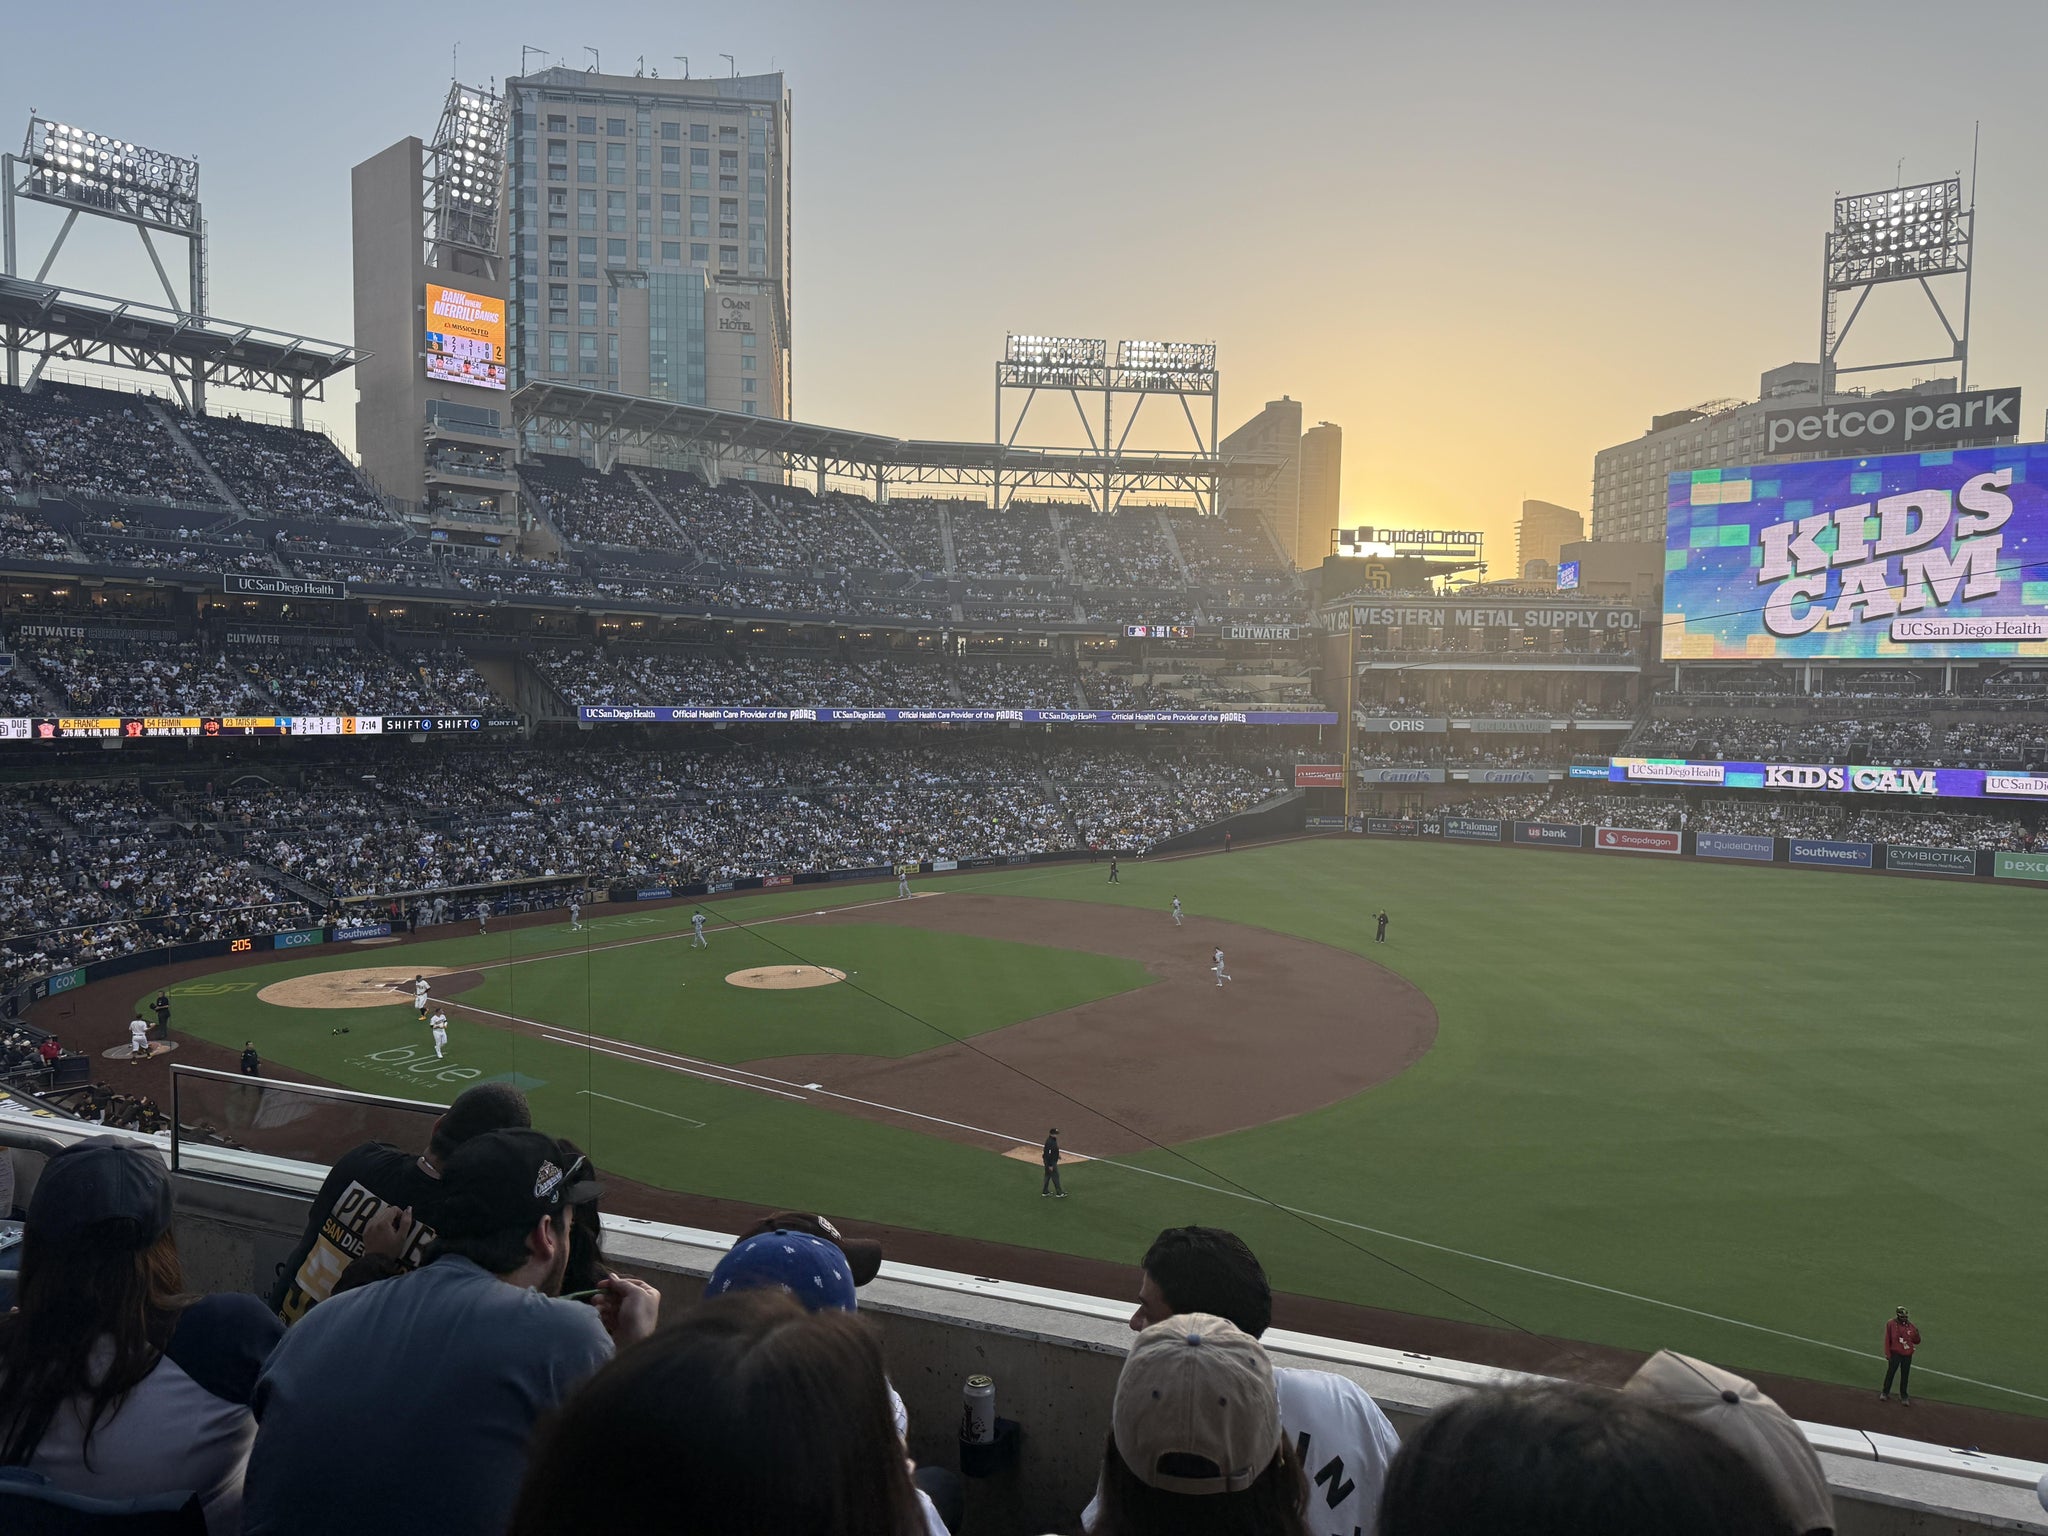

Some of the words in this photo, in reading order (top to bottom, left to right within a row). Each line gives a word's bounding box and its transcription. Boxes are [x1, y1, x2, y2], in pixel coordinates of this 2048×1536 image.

[441, 290, 466, 305] BANK
[433, 300, 476, 322] MERRILL
[475, 309, 500, 324] BANKS
[452, 323, 477, 334] MISSION
[451, 336, 456, 344] 2
[469, 339, 473, 348] 3
[451, 345, 456, 353] 2
[496, 346, 502, 357] 2
[1768, 408, 1895, 452] petco
[1904, 395, 2015, 441] park
[1757, 467, 2014, 584] KIDS
[1378, 529, 1477, 545] QuidelOrtho
[239, 578, 254, 590] UC
[254, 579, 275, 591] San
[276, 581, 303, 595] Diego
[304, 583, 334, 595] Health
[1763, 533, 2005, 637] CAM
[1353, 607, 1445, 626] WESTERN
[1455, 609, 1519, 627] METAL
[1525, 610, 1599, 628] SUPPLY
[1606, 611, 1639, 629] CO.
[20, 625, 85, 638] CUTWATER
[1231, 627, 1290, 639] CUTWATER
[1900, 623, 1923, 636] UC
[1924, 623, 1950, 636] San
[1953, 622, 1993, 637] Diego
[1995, 621, 2042, 635] Health
[226, 633, 280, 645] CUTWATER
[586, 708, 599, 718] UC
[599, 708, 612, 718] San
[613, 708, 633, 720] Diego
[633, 709, 656, 718] Health
[672, 709, 697, 719] Official
[699, 709, 722, 719] Health
[723, 709, 738, 719] Care
[740, 710, 768, 719] Provider
[768, 710, 776, 719] of
[777, 710, 788, 719] the
[790, 710, 816, 720] PADRES
[833, 710, 842, 719] UC
[869, 711, 886, 719] Health
[898, 710, 918, 719] Official
[919, 710, 936, 719] Health
[937, 711, 950, 719] Care
[951, 711, 974, 719] Provider
[975, 711, 983, 719] of
[983, 711, 994, 719] the
[996, 711, 1023, 720] PADRES
[1039, 711, 1049, 720] UC
[1049, 712, 1061, 720] San
[1061, 712, 1077, 721] Diego
[1135, 712, 1155, 721] Health
[1157, 713, 1172, 721] Care
[1173, 713, 1198, 721] Provider
[1199, 713, 1207, 721] of
[1207, 713, 1218, 721] the
[1220, 713, 1246, 723] PADRES
[12, 719, 26, 729] DUE
[62, 719, 71, 728] 25
[74, 719, 100, 728] FRANCE
[158, 718, 181, 727] FERMIN
[302, 718, 307, 726] 2
[319, 718, 324, 726] 3
[346, 719, 352, 730] 2
[361, 720, 377, 730] 7:14
[1389, 720, 1425, 731] ORIS
[16, 729, 27, 738] UP
[302, 726, 307, 734] 2
[1632, 764, 1647, 774] UC
[1647, 765, 1665, 775] San
[1665, 766, 1690, 777] Diego
[1691, 767, 1721, 778] Health
[1765, 765, 1845, 789] KIDS
[1852, 768, 1938, 794] CAM
[1991, 778, 2010, 789] UC
[2010, 778, 2032, 790] San
[1423, 824, 1440, 835] 342
[1460, 821, 1498, 832] Palomar
[1528, 828, 1541, 837] us
[1542, 828, 1566, 839] bank
[1621, 835, 1671, 846] Snapdragon
[1714, 841, 1769, 852] QuidelOrtho
[1795, 846, 1858, 860] Southwest
[1890, 850, 1972, 864] CYMBIOTIKA
[285, 933, 311, 945] COX
[338, 928, 382, 940] Southwest
[231, 939, 252, 951] 205
[56, 974, 76, 989] COX
[365, 1044, 482, 1082] blue
[343, 1057, 440, 1089] CALIFORNIA
[322, 1218, 345, 1243] SAN
[341, 1233, 366, 1257] DIE
